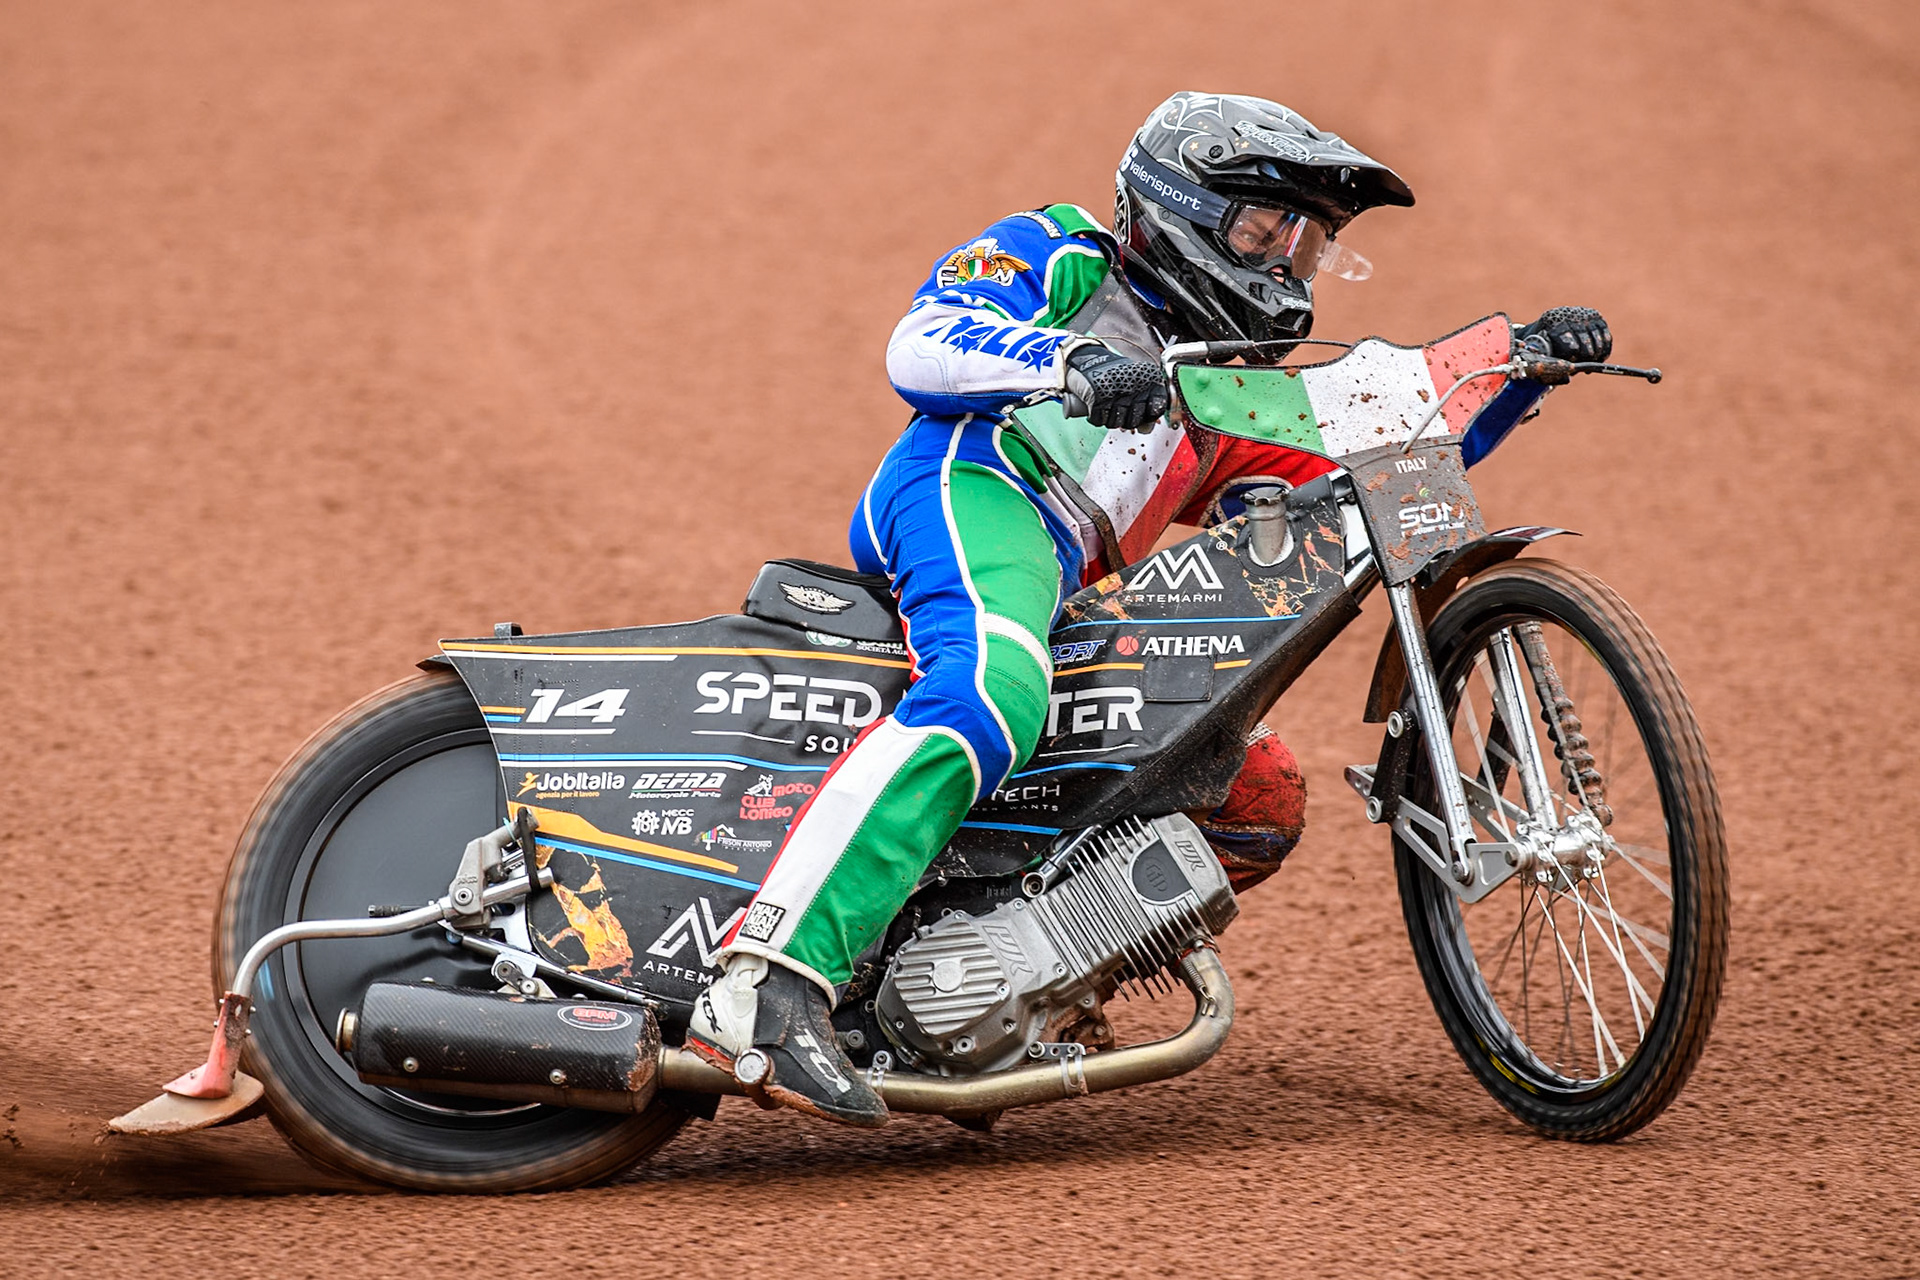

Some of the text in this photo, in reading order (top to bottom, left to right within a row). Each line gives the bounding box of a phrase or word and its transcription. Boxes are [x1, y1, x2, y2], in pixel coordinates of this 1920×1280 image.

[1130, 160, 1202, 211] valerisport
[1395, 457, 1428, 474] ITALY
[1125, 593, 1223, 603] ARTEMARMI
[1050, 639, 1107, 660] PORT
[1141, 635, 1245, 656] ATHENA
[525, 688, 630, 723] 14
[693, 671, 883, 728] SPEED
[1046, 687, 1144, 737] TER
[804, 734, 857, 754] SQU
[537, 772, 625, 791] JobItalia
[631, 772, 727, 790] DEFRA
[690, 790, 722, 798] Parts
[741, 795, 776, 808] CLUB
[643, 960, 714, 986] ARTEM
